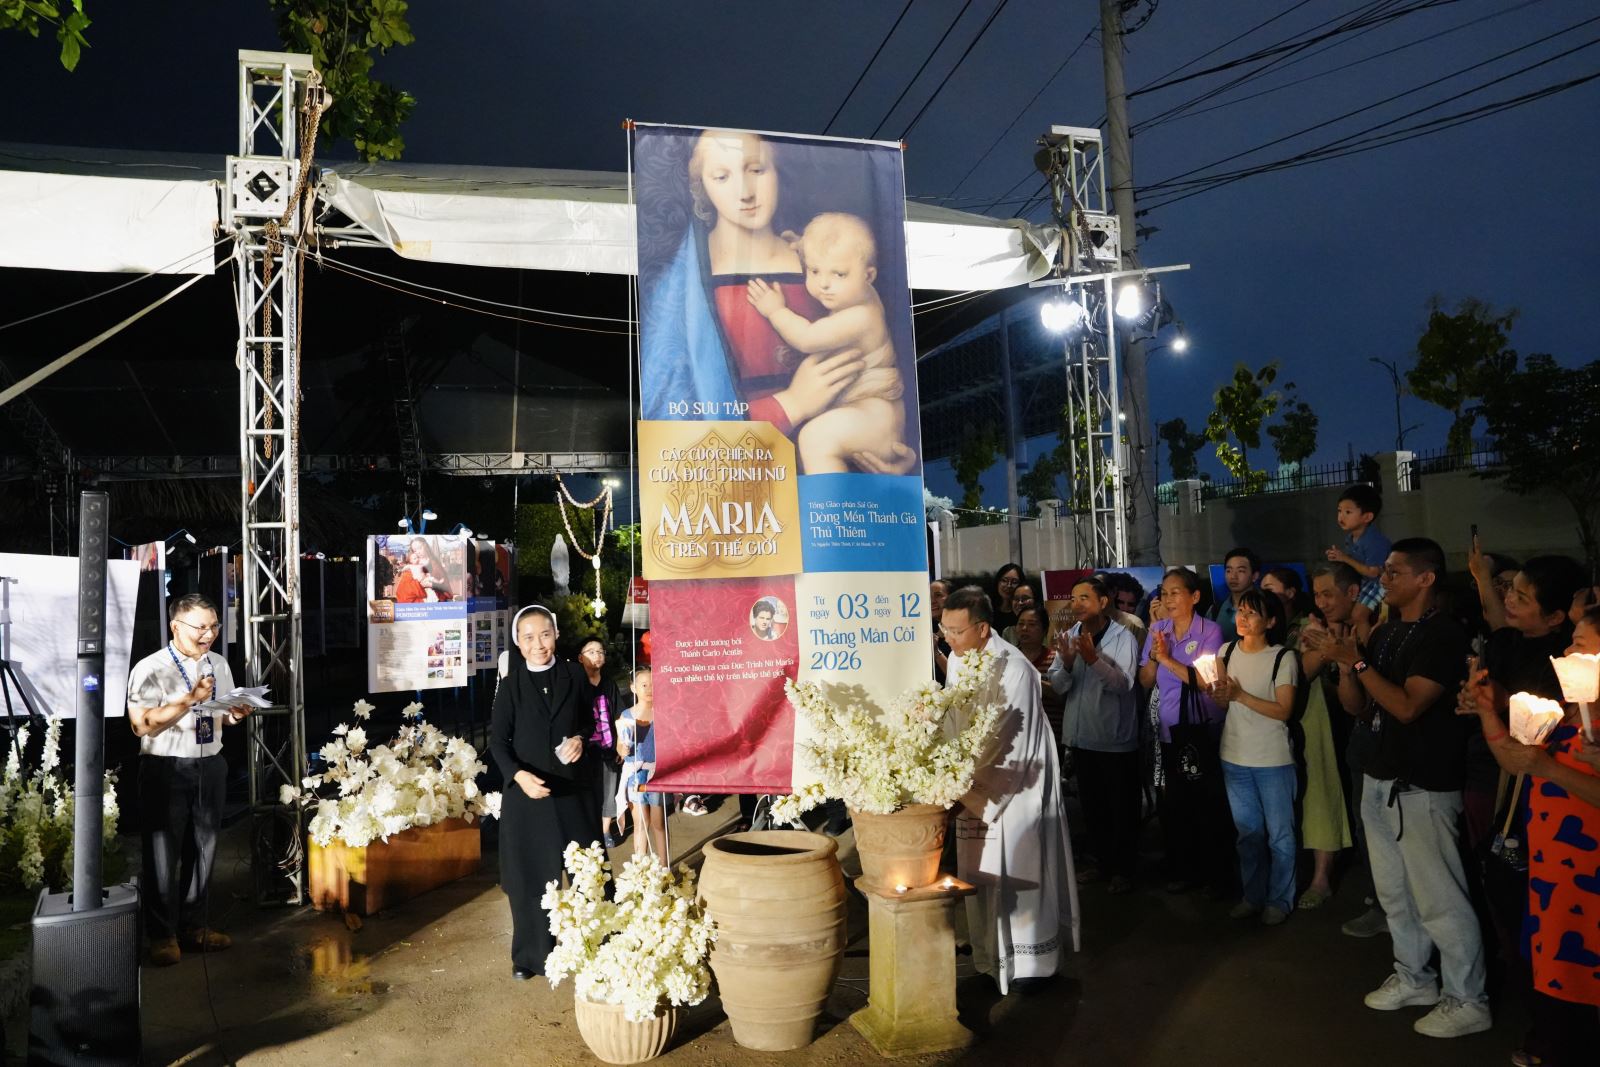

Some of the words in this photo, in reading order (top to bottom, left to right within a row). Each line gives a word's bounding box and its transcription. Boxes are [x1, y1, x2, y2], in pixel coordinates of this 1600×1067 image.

[669, 400, 689, 416] BỘ
[692, 401, 719, 415] SƯU
[723, 400, 749, 416] TẬP
[660, 447, 687, 461] CÁC
[690, 447, 726, 463] CUỘC
[727, 447, 754, 463] HIỆN
[757, 448, 774, 461] RA
[684, 465, 714, 482] ĐỨC
[717, 466, 763, 482] TRINH
[765, 464, 787, 482] NỮ
[658, 501, 782, 536] MARIA
[809, 511, 840, 525] Dòng
[843, 510, 865, 523] Mến
[868, 511, 898, 524] Thánh
[810, 525, 832, 538] Thủ
[836, 526, 867, 538] Thiêm
[666, 539, 708, 558] TRÊN
[711, 537, 744, 556] THẾ
[745, 538, 778, 556] GIỚI
[810, 608, 830, 619] ngày
[837, 593, 869, 620] 03
[899, 592, 920, 618] 12
[810, 628, 856, 648] Tháng
[860, 627, 889, 643] Mân
[893, 626, 915, 642] Côi
[680, 649, 700, 658] Thánh
[702, 649, 721, 657] Carlo
[722, 648, 743, 656] Acutis
[810, 650, 862, 671] 2026
[660, 665, 673, 673] 154
[746, 660, 763, 669] Trinh
[775, 657, 794, 666] Maria
[670, 676, 683, 685] qua
